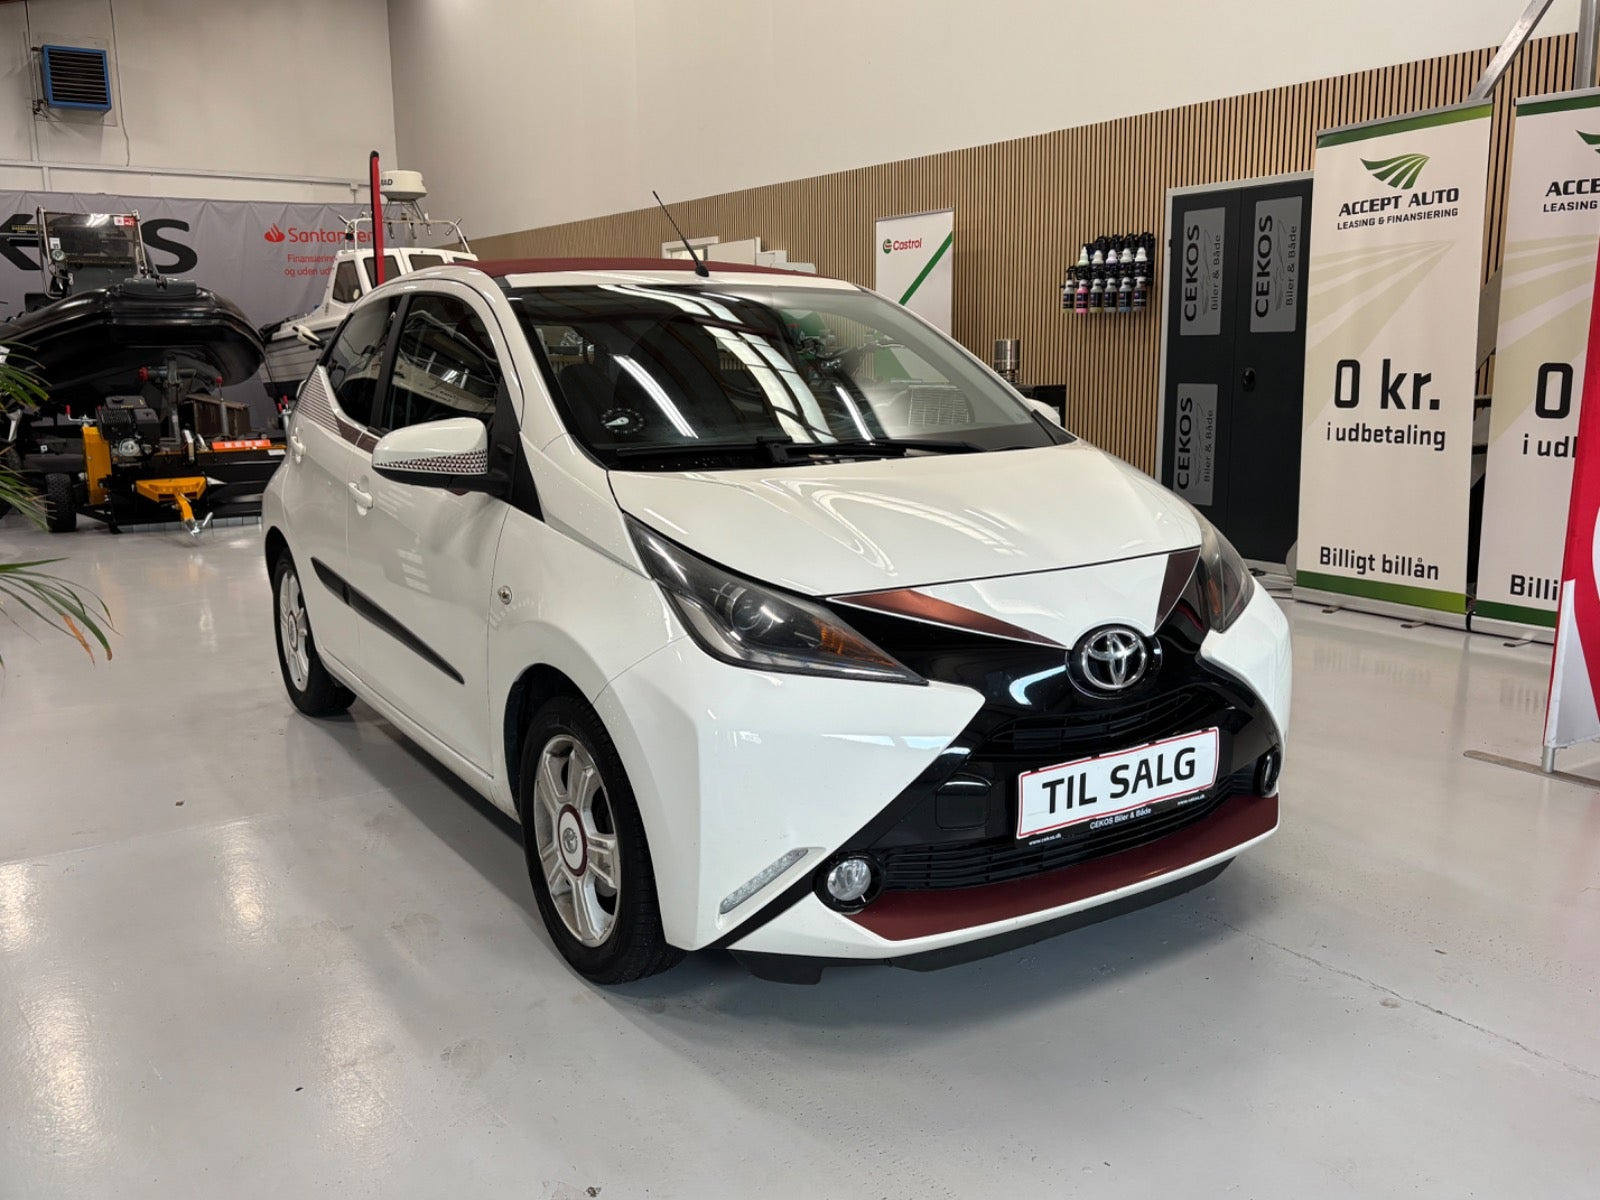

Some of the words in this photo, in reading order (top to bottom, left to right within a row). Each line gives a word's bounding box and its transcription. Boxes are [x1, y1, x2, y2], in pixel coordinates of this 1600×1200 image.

[1338, 195, 1402, 217] ACCEPT
[1408, 187, 1460, 208] AUTO
[1543, 200, 1598, 213] LEASING
[1337, 216, 1376, 231] LEASING
[1378, 216, 1385, 225] &
[1386, 208, 1459, 225] FINANSIERING
[893, 238, 922, 251] Castrol
[1288, 225, 1297, 258] Både
[1184, 224, 1200, 322] CEKOS
[1255, 215, 1273, 318] CEKOS
[1287, 264, 1295, 273] &
[1210, 284, 1219, 310] Biler
[1286, 279, 1295, 306] Biler
[1334, 359, 1361, 409] 0
[1380, 358, 1440, 410] kr.
[1535, 362, 1573, 419] 0
[1177, 397, 1192, 490] CEKOS
[1327, 421, 1331, 441] i
[1336, 422, 1446, 451] udbetaling
[1522, 433, 1529, 455] i
[1319, 546, 1375, 575] Billigt
[1382, 553, 1439, 581] billån
[1041, 772, 1098, 814] TIL
[1109, 747, 1196, 799] SALG
[1089, 816, 1113, 830] CEKOS
[1114, 813, 1129, 823] Biler
